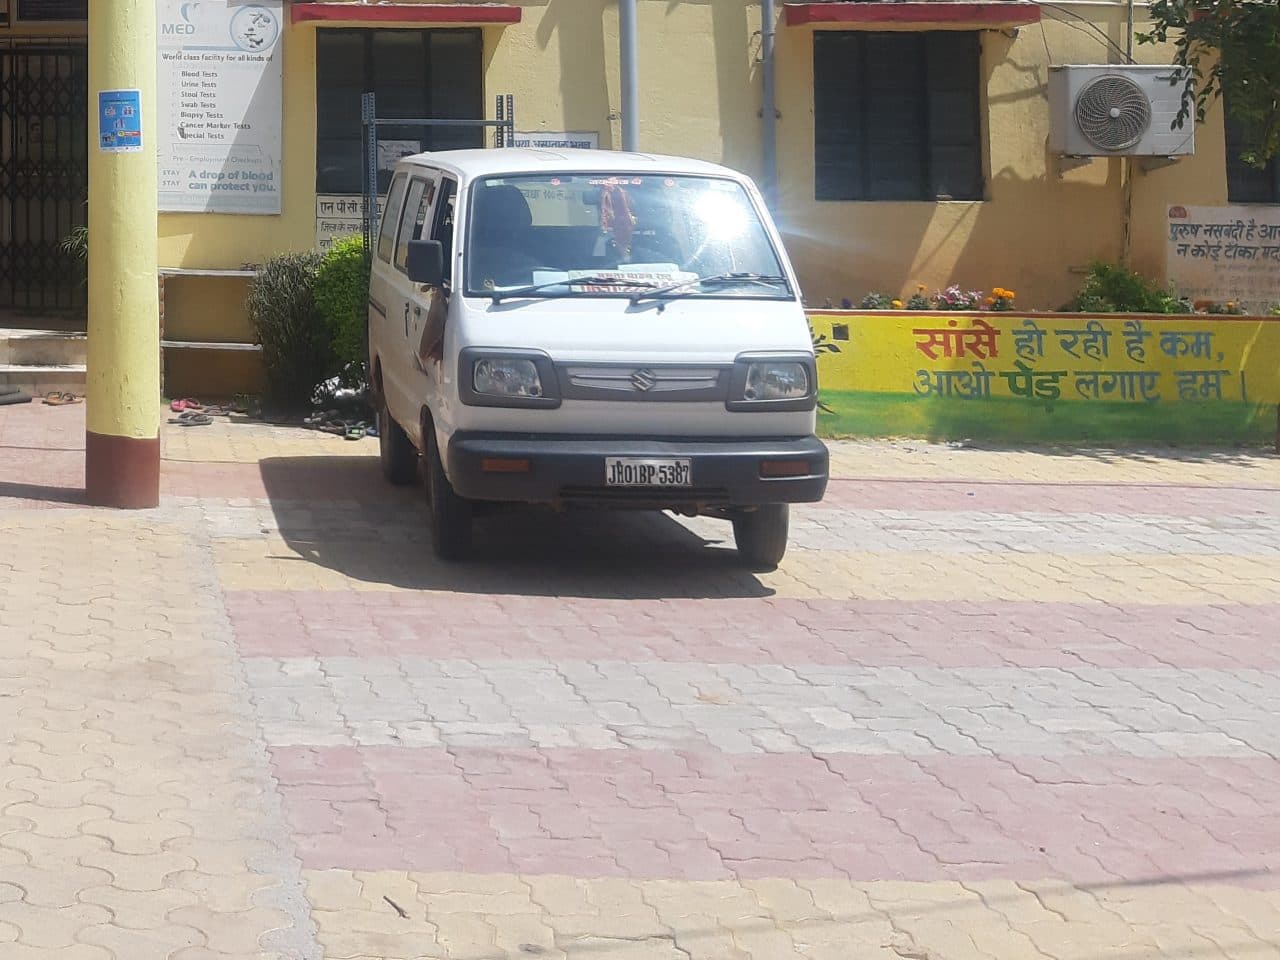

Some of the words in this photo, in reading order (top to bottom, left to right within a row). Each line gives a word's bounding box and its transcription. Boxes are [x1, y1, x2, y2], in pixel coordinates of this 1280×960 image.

[162, 24, 195, 35] MED
[162, 53, 182, 61] World
[183, 53, 200, 61] class
[246, 54, 265, 62] kinds
[200, 101, 216, 109] Tests
[180, 111, 204, 119] Biopsy
[180, 121, 204, 129] Cancer
[234, 122, 251, 130] Tests
[181, 132, 205, 140] pecial
[207, 132, 225, 140] Tests
[188, 170, 197, 178] A
[199, 170, 225, 181] drop
[227, 170, 239, 179] of
[242, 170, 274, 180] blood
[188, 182, 207, 190] can
[211, 182, 250, 192] protect
[252, 183, 276, 192] you.
[1012, 319, 1047, 362] हो
[1055, 321, 1112, 361] रही
[1121, 320, 1153, 363] है
[913, 361, 997, 401] आओ
